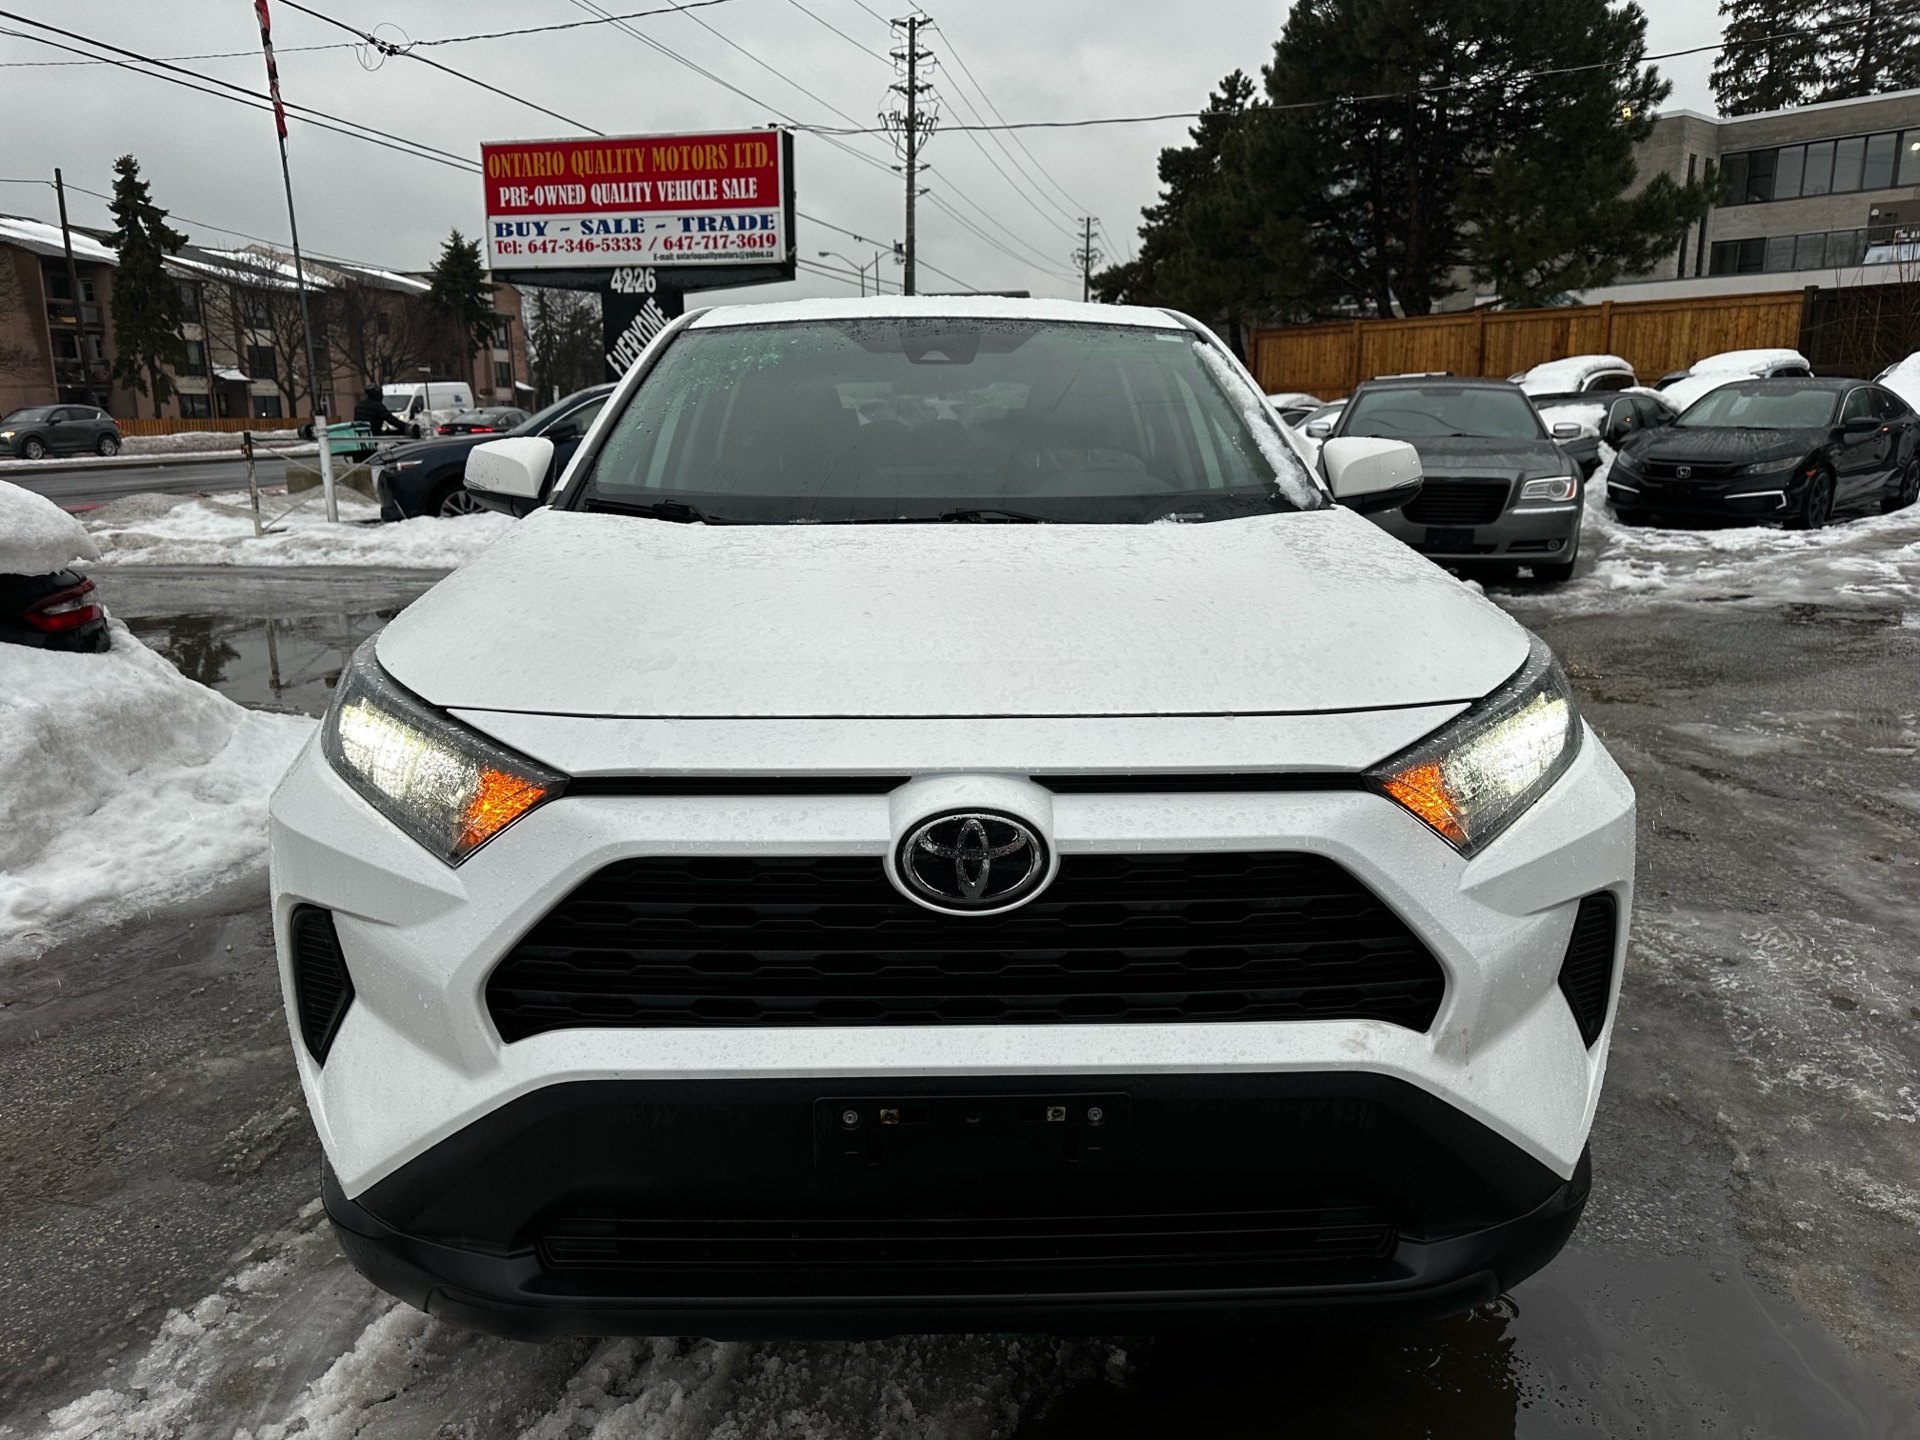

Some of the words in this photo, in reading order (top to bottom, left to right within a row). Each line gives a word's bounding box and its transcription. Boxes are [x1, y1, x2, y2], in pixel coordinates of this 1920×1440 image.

[488, 150, 565, 179] ONTARIO
[570, 148, 645, 178] QUALITY
[651, 143, 728, 173] MOTORS
[733, 141, 774, 169] LTD.
[499, 184, 587, 208] PRE-OWNED
[590, 181, 652, 207] QUALITY
[656, 178, 718, 203] VEHICLE
[722, 176, 758, 200] SALE
[494, 221, 549, 238] BUY
[580, 218, 645, 236] SALE
[677, 214, 775, 233] TRADE
[495, 239, 522, 254] Tel:
[527, 236, 643, 254] 647-346-5333
[663, 232, 777, 251] 647-717-3619
[653, 252, 675, 261] E-mail:
[610, 266, 657, 294] 4226
[606, 296, 671, 378] EVERYONE
